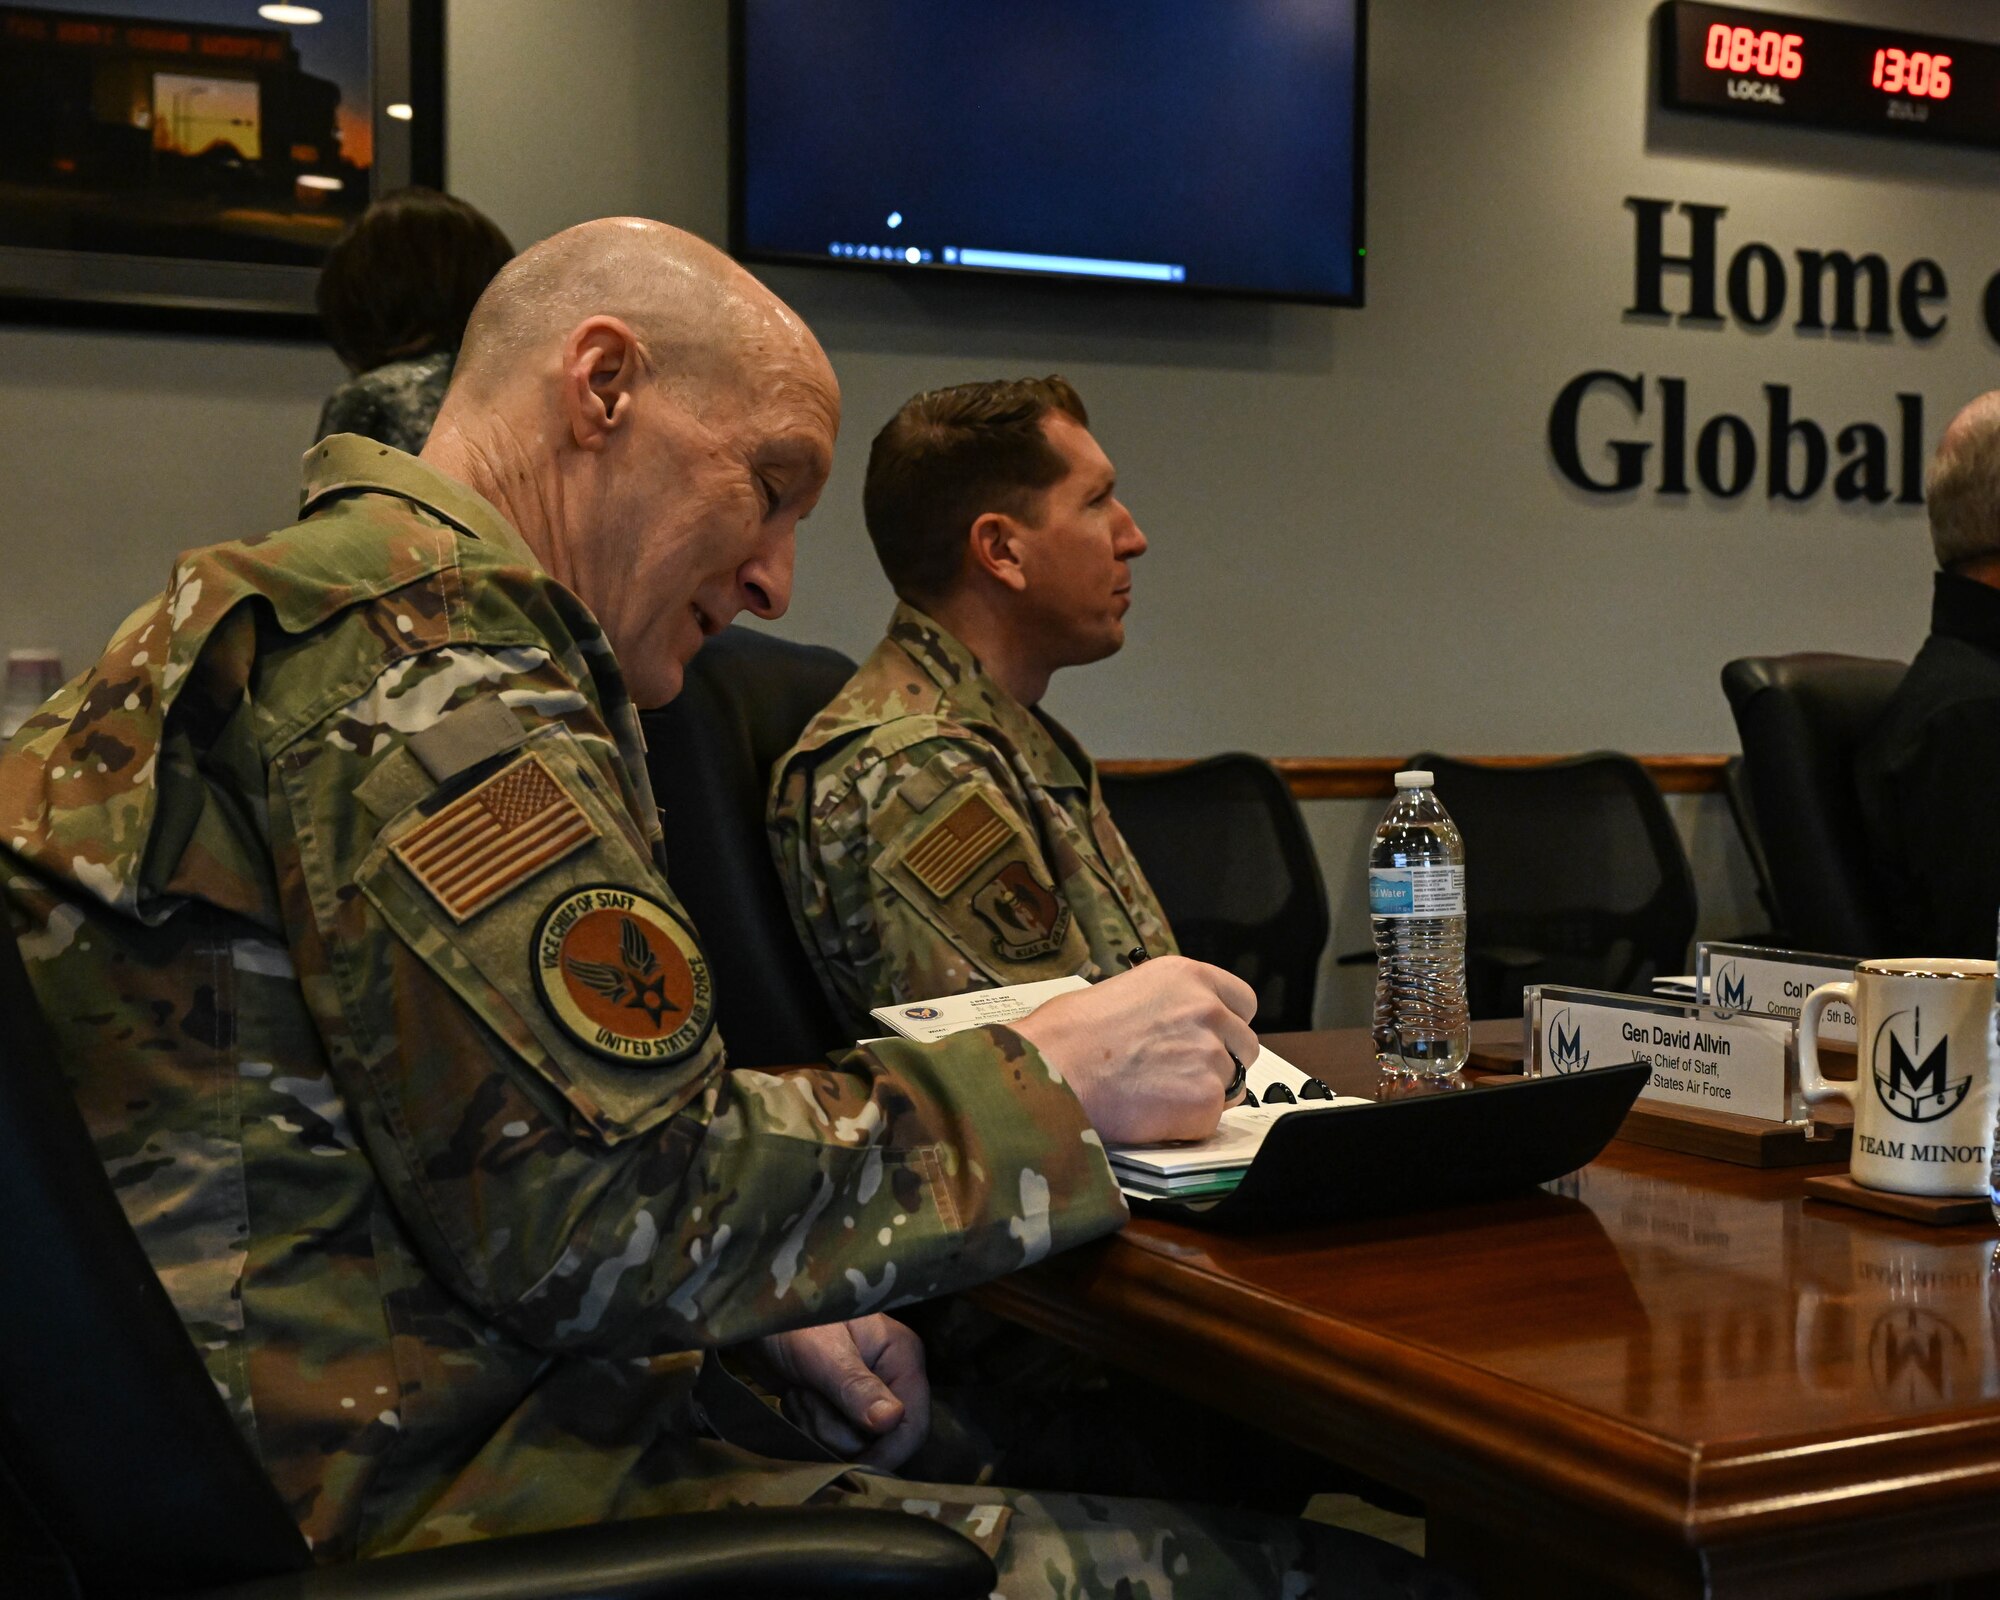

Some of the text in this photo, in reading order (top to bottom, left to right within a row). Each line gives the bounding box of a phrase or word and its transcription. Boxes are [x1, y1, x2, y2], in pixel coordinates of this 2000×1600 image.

[1706, 23, 1804, 79] 08:06
[1872, 48, 1952, 99] 13:06
[1727, 79, 1785, 105] LOCAL
[1621, 196, 1948, 340] Home
[1548, 368, 1926, 505] Global
[1380, 888, 1407, 898] Water
[543, 892, 636, 969] VICE CHIEF OF STAFF
[1784, 981, 1803, 998] Col
[595, 1028, 651, 1056] UNITED
[654, 1024, 697, 1055] STATES
[688, 956, 709, 1003] FORCE
[1827, 1009, 1842, 1024] 5th
[1844, 1011, 1857, 1026] Bo
[1622, 1022, 1731, 1056] Gen David Allvin
[1655, 1053, 1680, 1070] Chief
[1682, 1057, 1692, 1071] of
[1695, 1059, 1720, 1078] Staff,
[1654, 1074, 1684, 1091] States
[1686, 1079, 1699, 1094] Air
[1703, 1082, 1731, 1099] Force
[1859, 1135, 1986, 1164] TEAM MINOT
